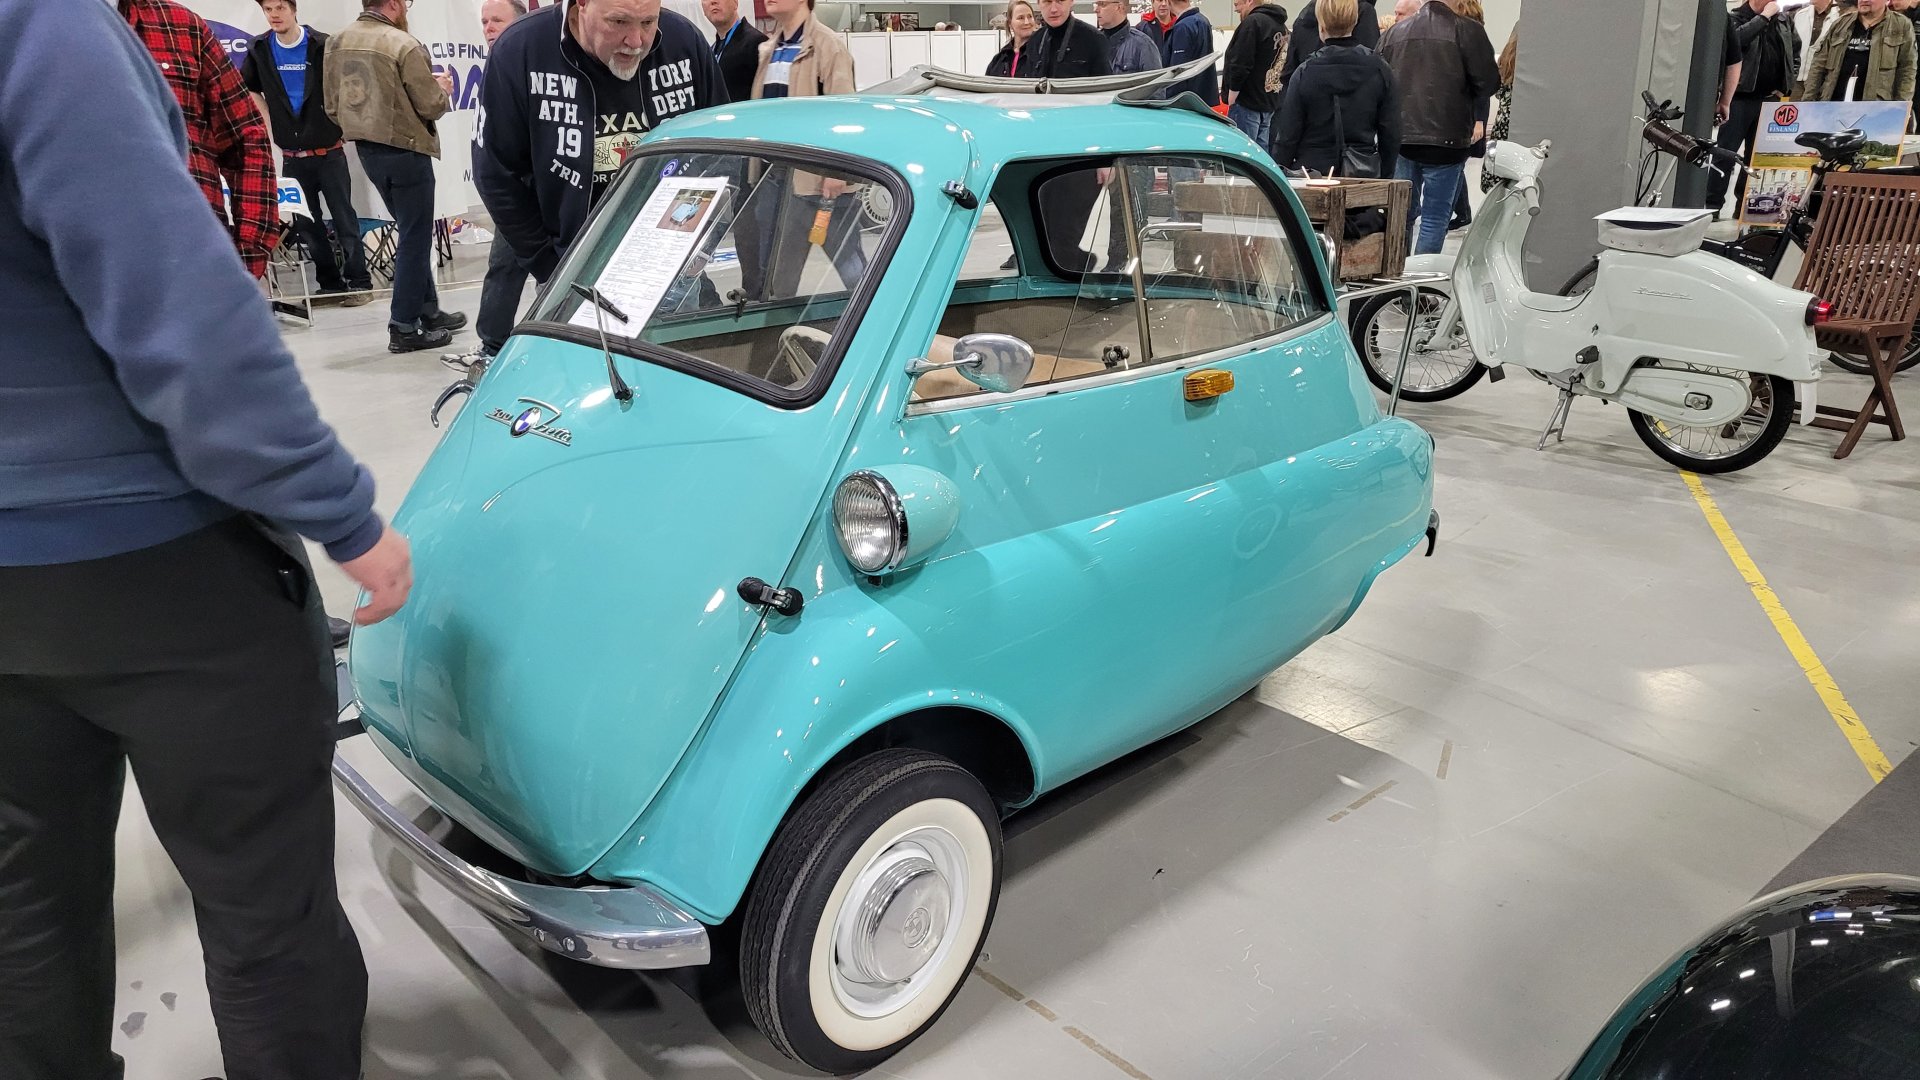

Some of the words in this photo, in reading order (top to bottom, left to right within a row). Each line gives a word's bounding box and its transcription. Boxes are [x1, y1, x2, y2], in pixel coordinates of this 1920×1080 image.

[529, 71, 578, 99] NEW
[648, 58, 693, 91] YORK
[538, 99, 583, 126] ATH.
[652, 85, 696, 116] DEPT
[556, 126, 582, 158] 19
[550, 159, 583, 189] TRD.
